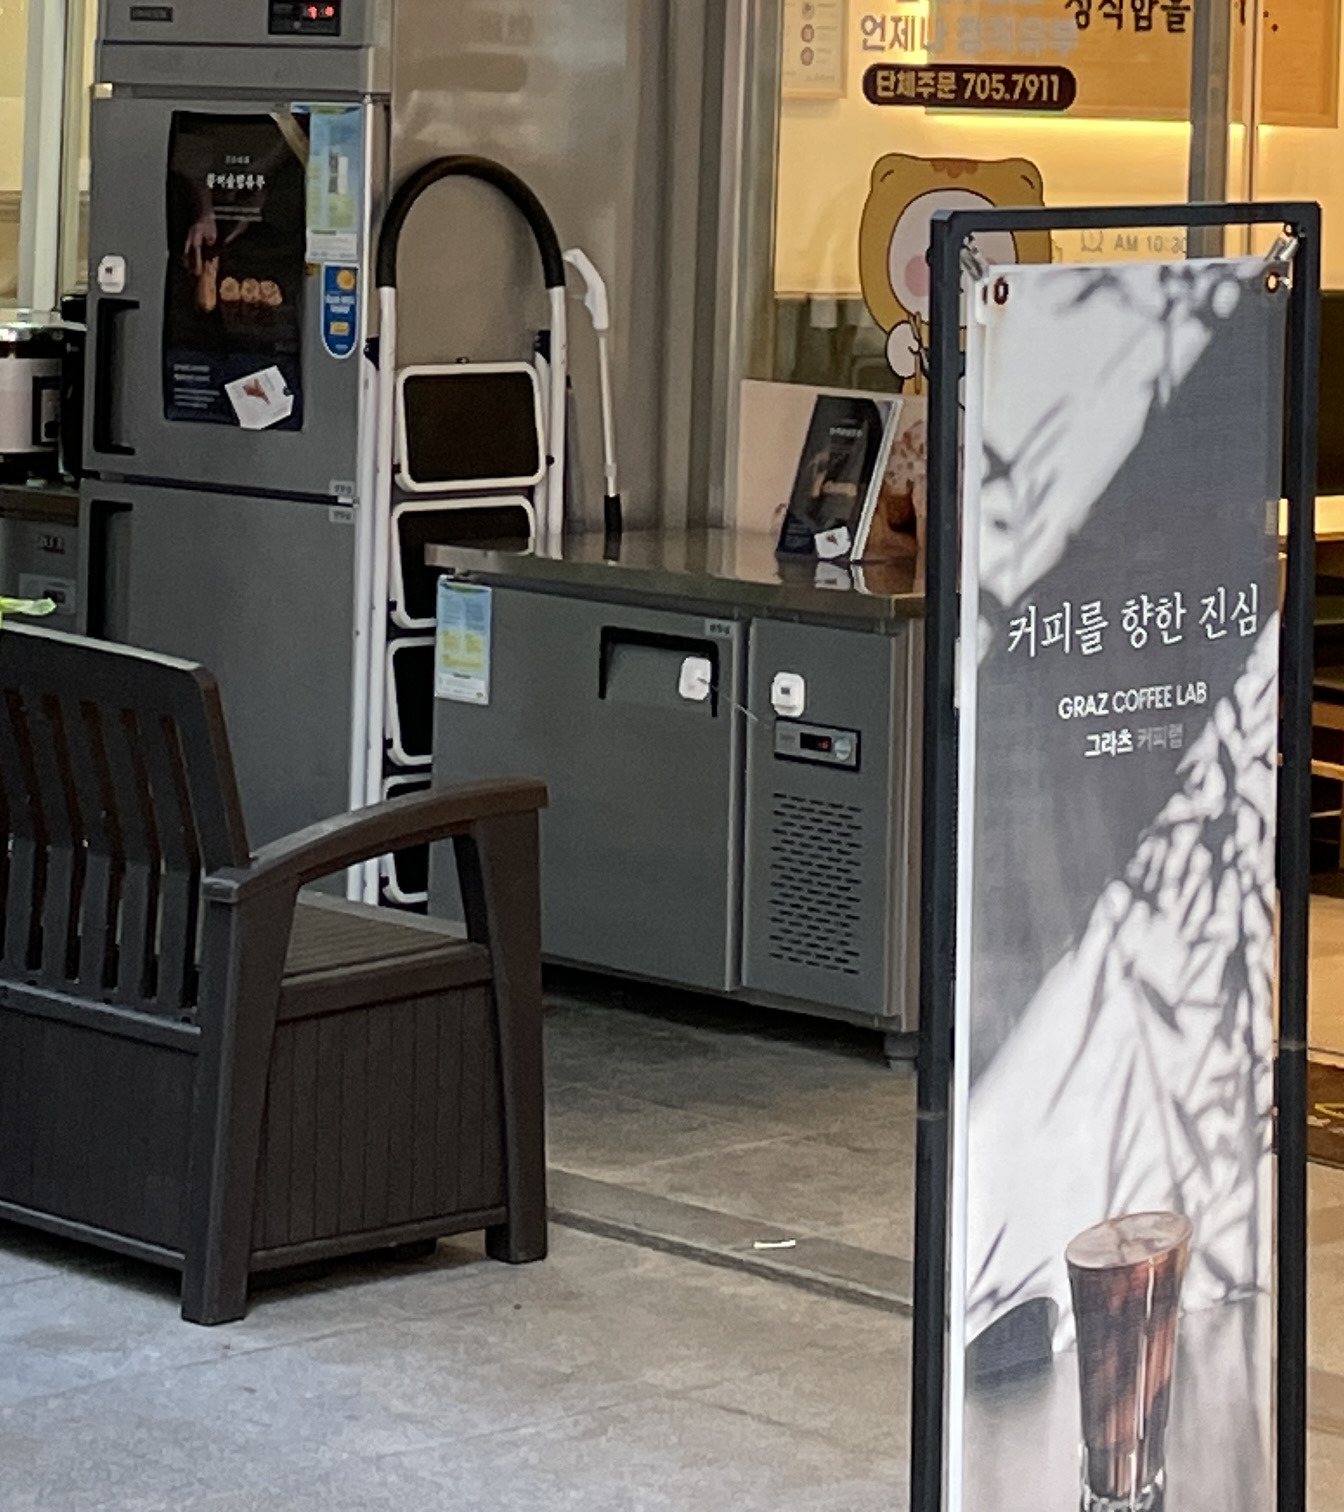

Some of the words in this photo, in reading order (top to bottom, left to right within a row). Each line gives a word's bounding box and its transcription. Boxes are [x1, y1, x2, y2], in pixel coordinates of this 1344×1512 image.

[875, 69, 958, 101] 단체주문
[962, 72, 1061, 103] 705.7911
[1008, 600, 1109, 658] 커피를
[1121, 591, 1187, 649] 향한
[1198, 583, 1261, 642] 진심
[1058, 692, 1110, 720] GRAZ
[1111, 685, 1173, 715] COFFEE
[1176, 681, 1207, 707] LAB
[1084, 728, 1134, 760] 그라츠
